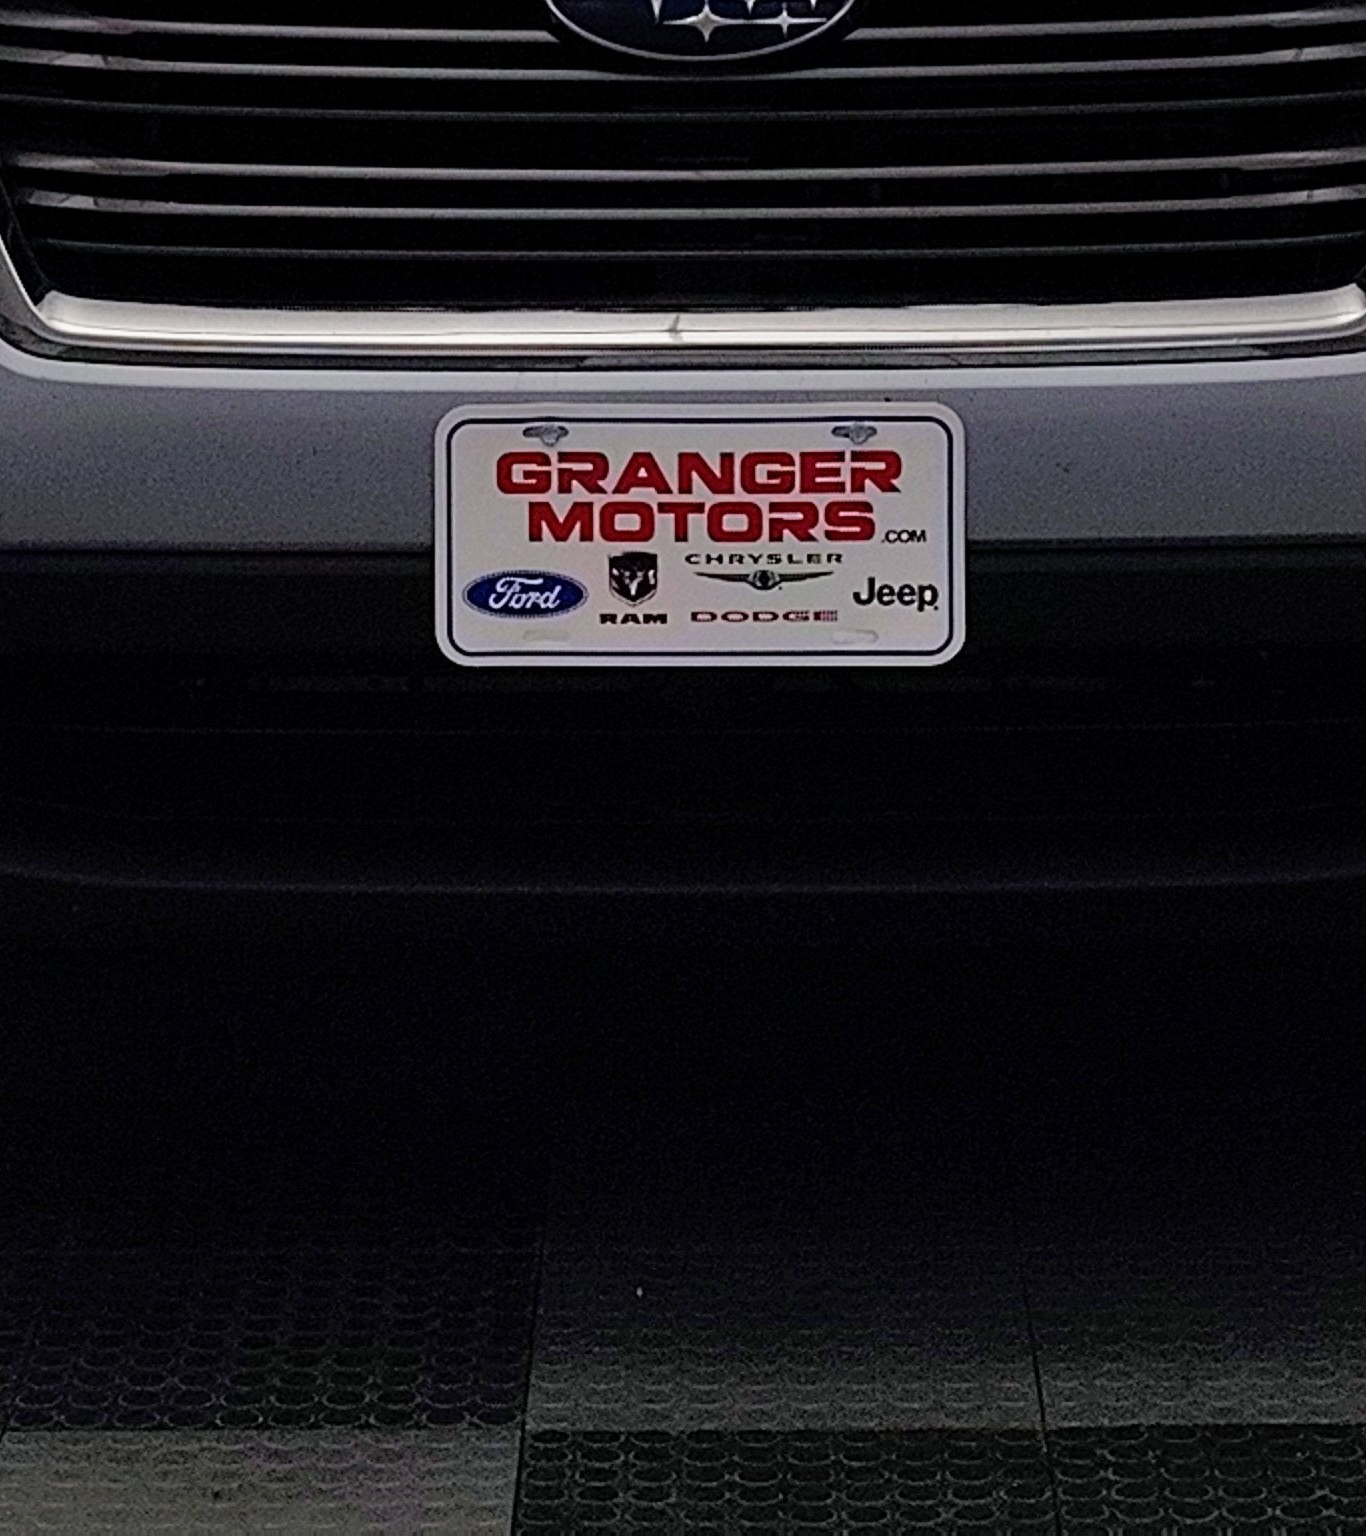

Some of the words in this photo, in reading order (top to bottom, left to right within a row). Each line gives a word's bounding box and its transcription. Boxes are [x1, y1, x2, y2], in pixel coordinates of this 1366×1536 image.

[495, 450, 904, 496] GRANGER
[528, 500, 877, 544] MOTORS
[684, 552, 844, 566] CHRYSLER
[487, 576, 562, 612] Ford
[852, 576, 939, 612] Jeep
[598, 611, 669, 626] RAM
[690, 608, 839, 624] DODGE
